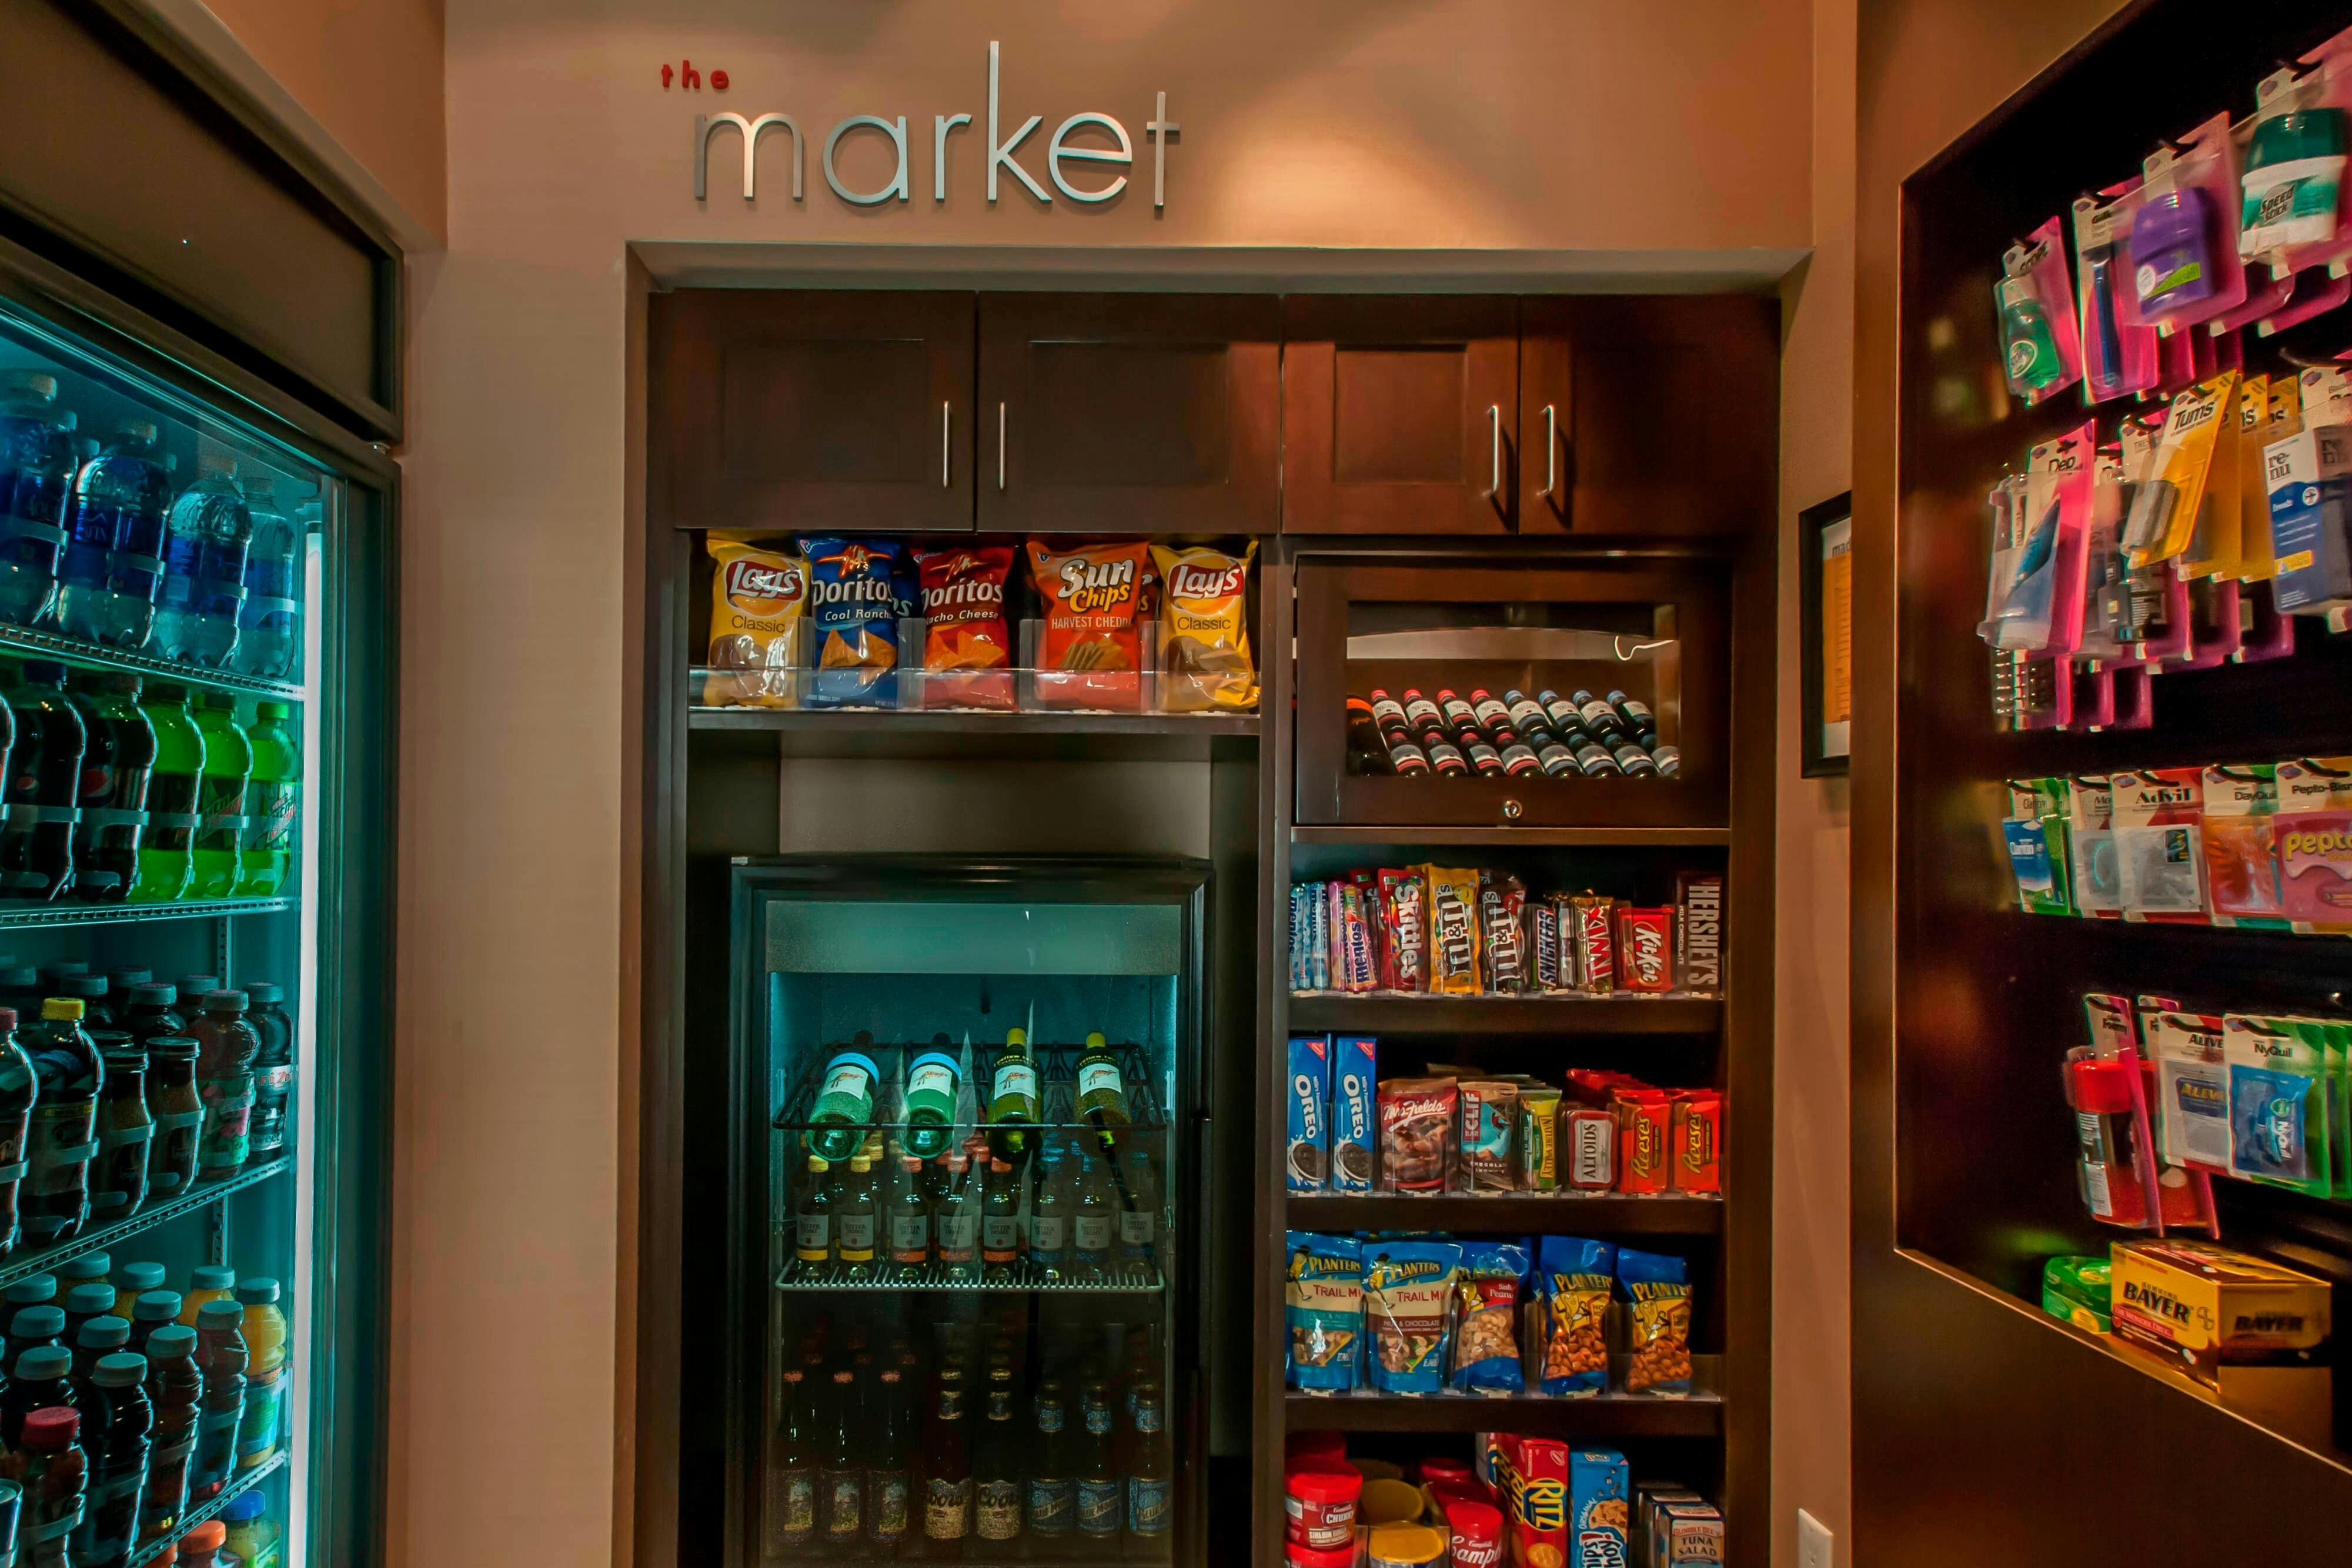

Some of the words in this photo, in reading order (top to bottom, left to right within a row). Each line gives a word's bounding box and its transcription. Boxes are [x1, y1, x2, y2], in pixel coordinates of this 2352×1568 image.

[660, 60, 729, 89] the
[693, 41, 1180, 210] market
[2174, 401, 2216, 430] Tums
[2048, 456, 2075, 474] Dep
[1057, 559, 1134, 598] Sun
[1068, 584, 1131, 613] Chips
[731, 615, 786, 633] Classic
[824, 609, 850, 621] Cool
[855, 609, 889, 619] Ranch
[927, 613, 954, 626] acho
[959, 610, 998, 620] Cheese
[1052, 616, 1093, 630] HARVEST
[1177, 617, 1232, 631] Classic
[2135, 788, 2192, 804] Advil
[2234, 790, 2277, 803] DayQui
[1394, 884, 1422, 979] Skittles
[1687, 884, 1720, 985] HERSHEY'S
[1351, 922, 1369, 983] mentos
[2254, 1043, 2293, 1058] NyQuil
[1295, 1074, 1316, 1139] OREO
[1343, 1074, 1364, 1139] OREO
[1465, 1092, 1479, 1131] CLIF
[1583, 1124, 1598, 1178] ALTOIDS
[1308, 1257, 1361, 1272] PLANTERS
[1313, 1284, 1347, 1298] TRAIL
[1348, 1288, 1361, 1298] MI
[1555, 1273, 1612, 1292] PLANTER
[1396, 1290, 1429, 1302] TRAIL
[2123, 1281, 2190, 1324] BAYER
[1529, 1481, 1565, 1529] RITZ
[1682, 1536, 1713, 1547] TUNA
[1678, 1546, 1716, 1557] SALAD
